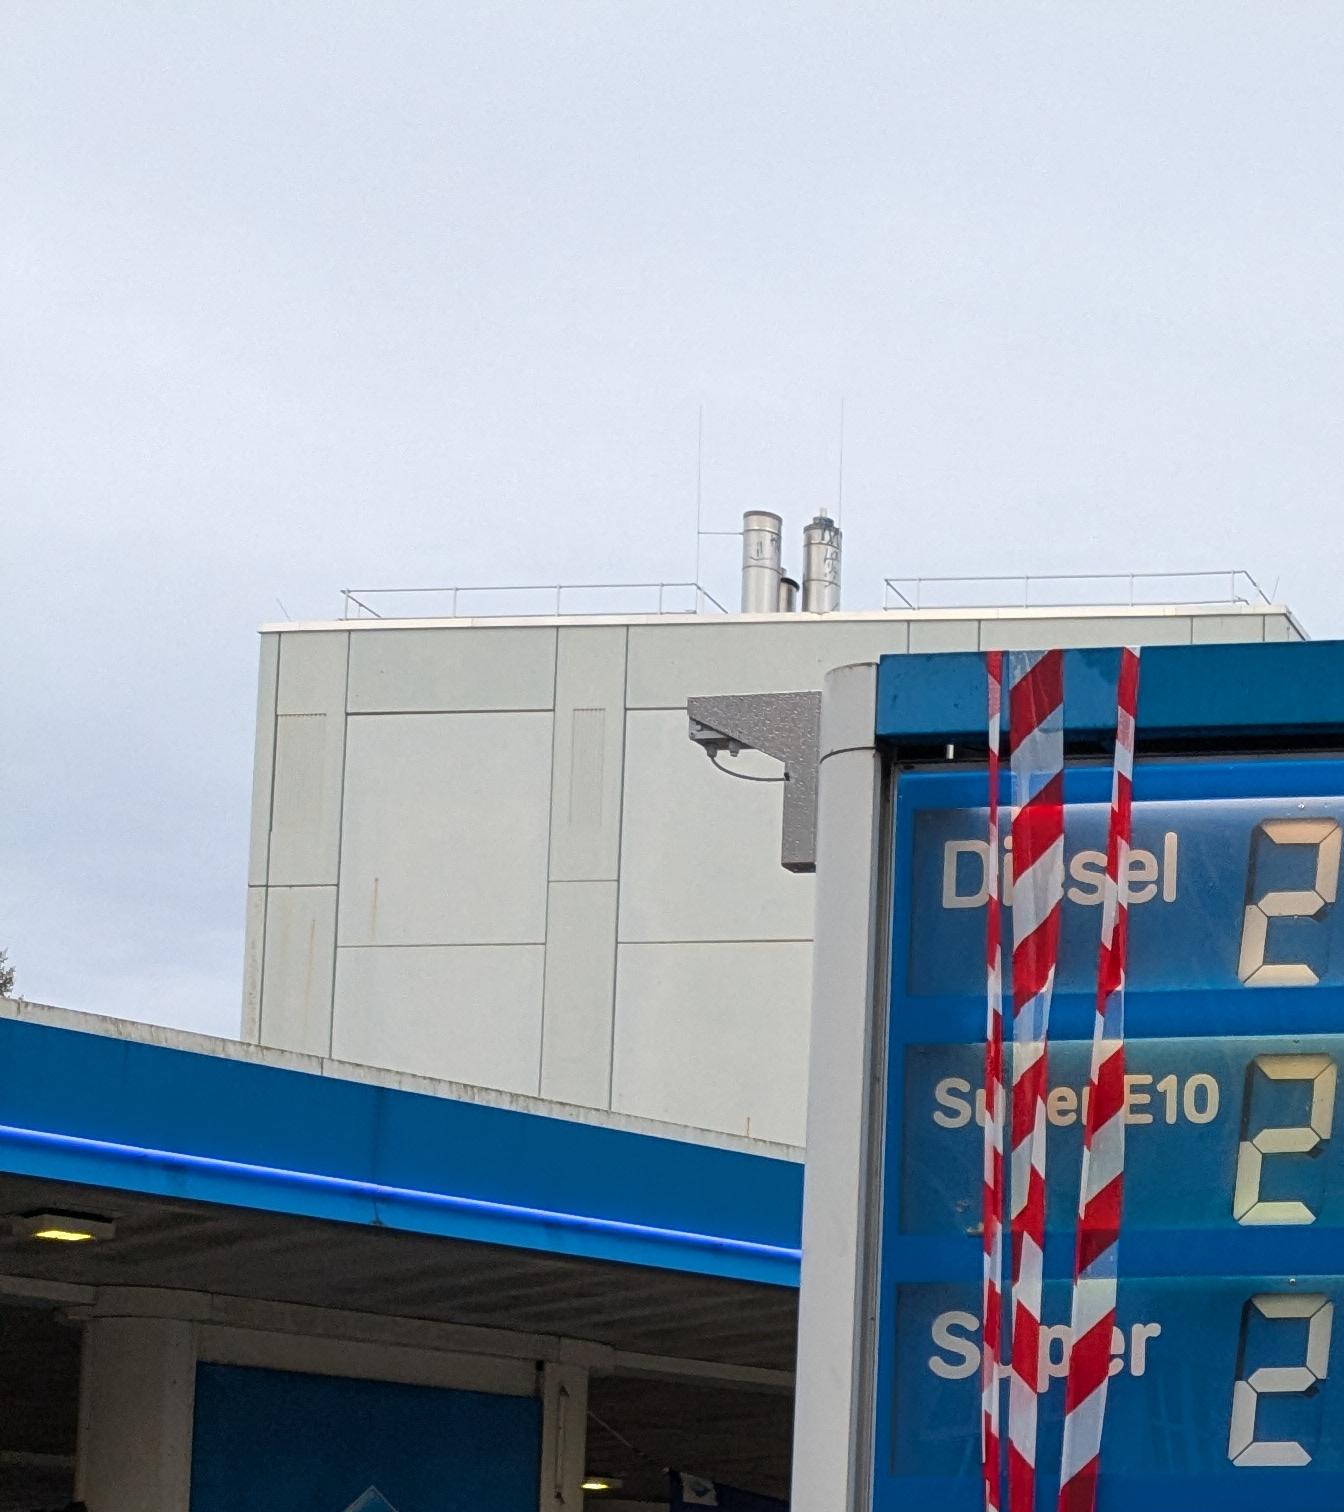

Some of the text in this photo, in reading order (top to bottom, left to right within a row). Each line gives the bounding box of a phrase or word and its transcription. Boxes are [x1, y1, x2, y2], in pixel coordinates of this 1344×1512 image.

[942, 831, 1178, 909] Disel
[1124, 1073, 1220, 1125] E10
[928, 1310, 1162, 1393] Spr
